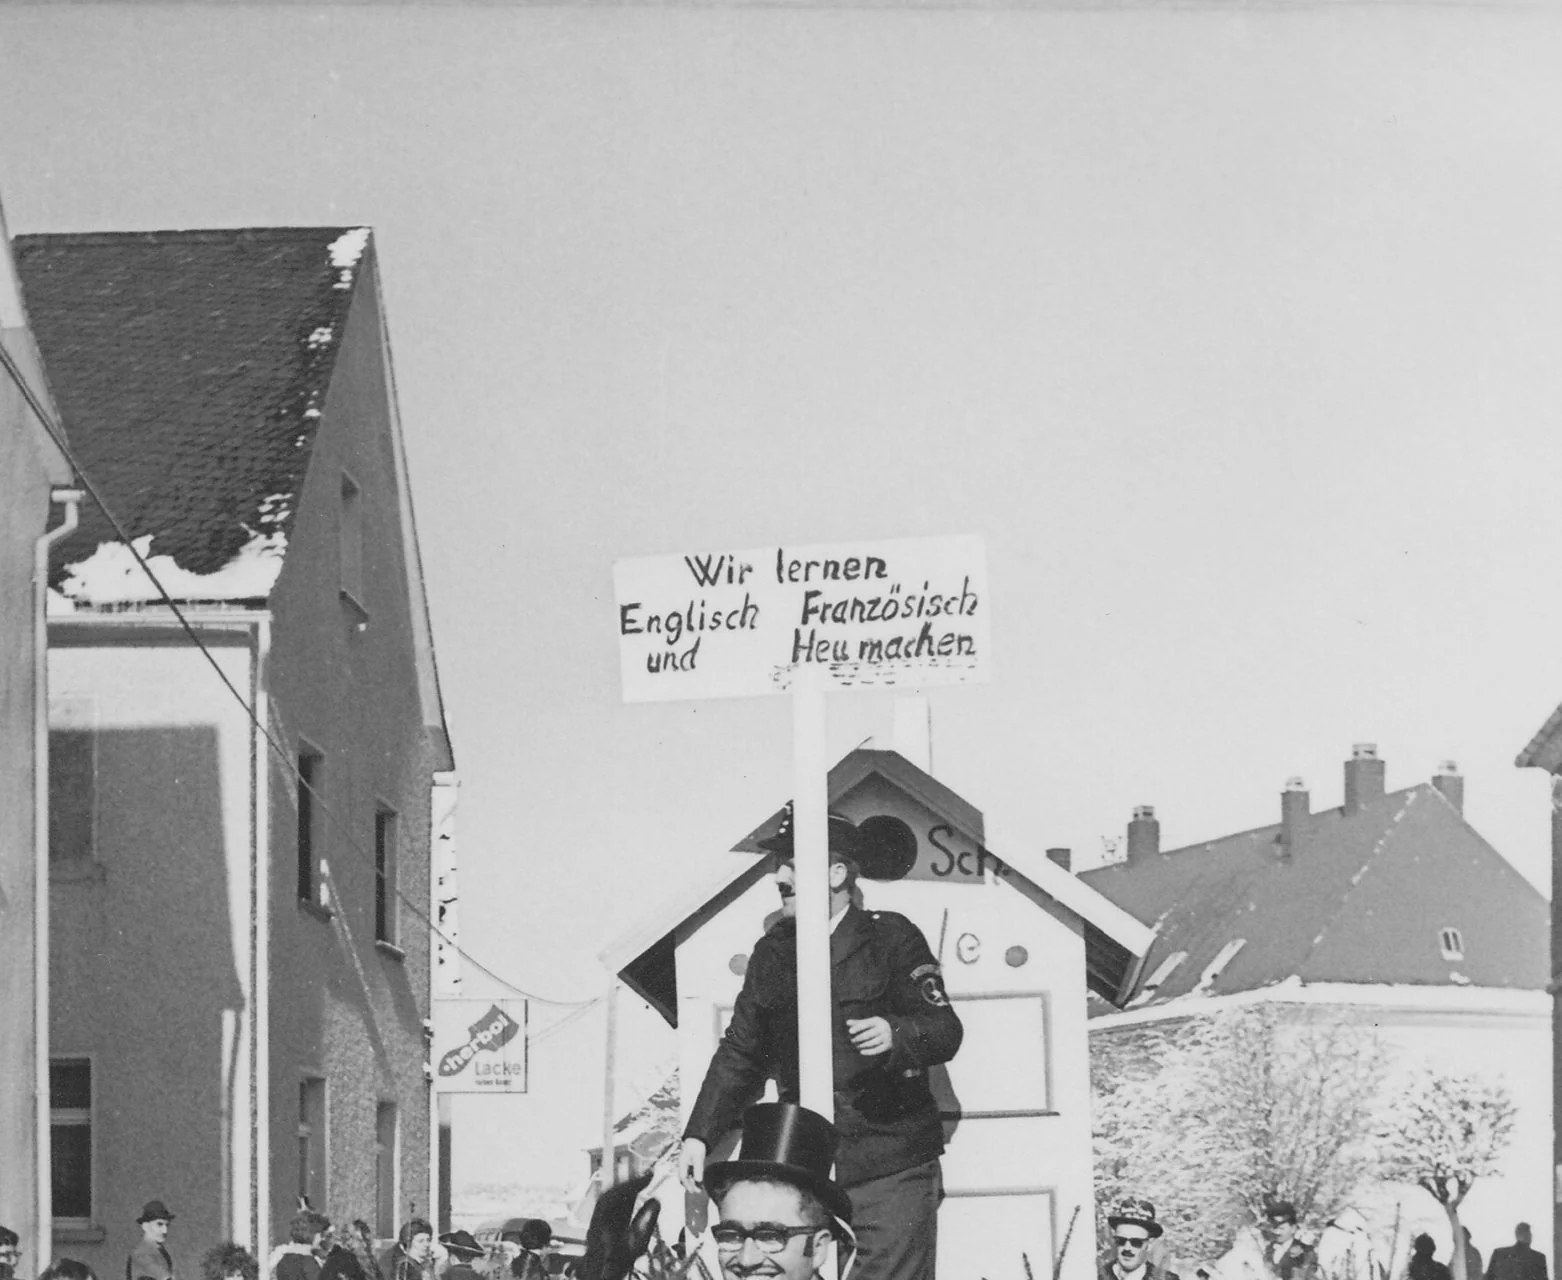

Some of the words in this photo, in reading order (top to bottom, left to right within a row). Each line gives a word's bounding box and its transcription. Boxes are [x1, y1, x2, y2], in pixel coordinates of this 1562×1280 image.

[684, 554, 753, 587] Wir
[776, 547, 888, 584] lernen
[619, 592, 760, 646] Englisch
[800, 575, 979, 626] Französisch
[646, 635, 702, 674] und
[474, 1061, 522, 1076] Lacke
